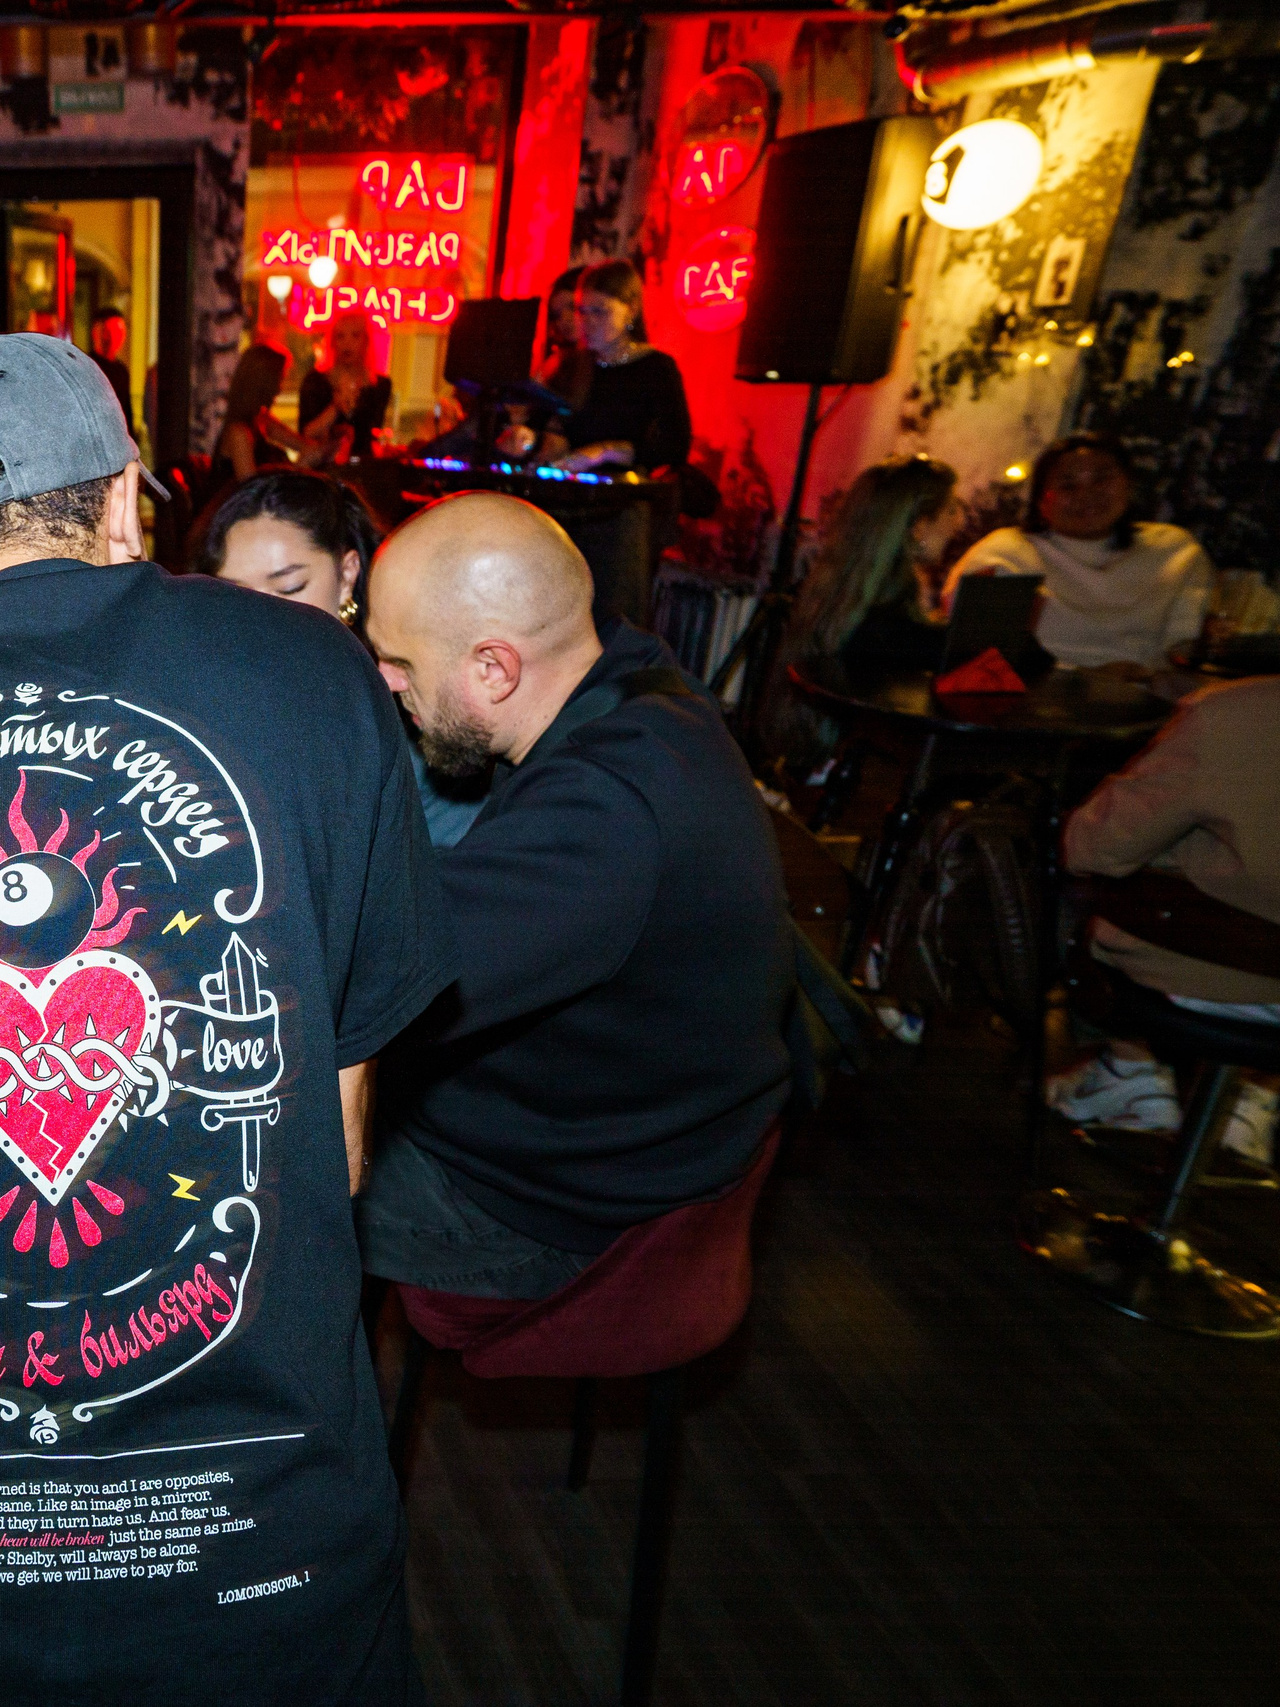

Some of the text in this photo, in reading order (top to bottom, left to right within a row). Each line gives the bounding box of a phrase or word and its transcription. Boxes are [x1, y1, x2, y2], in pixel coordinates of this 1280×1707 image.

[2, 870, 28, 902] 8
[203, 1021, 268, 1073] love
[22, 1330, 65, 1388] &
[80, 1263, 234, 1378] бильярд
[29, 1483, 41, 1495] is
[43, 1481, 71, 1495] that
[74, 1483, 99, 1496] you
[102, 1480, 128, 1495] and
[130, 1479, 137, 1492] I
[140, 1479, 163, 1490] are
[165, 1471, 234, 1489] opposites,
[37, 1499, 68, 1512] Like
[70, 1500, 87, 1511] an
[90, 1498, 131, 1512] image
[134, 1495, 149, 1508] in
[151, 1497, 161, 1506] a
[162, 1490, 212, 1505] mirror.
[0, 1533, 29, 1547] heart
[30, 1533, 51, 1547] will
[51, 1533, 65, 1546] be
[65, 1531, 105, 1546] broken
[107, 1531, 137, 1547] just
[138, 1528, 162, 1541] the
[165, 1526, 201, 1539] same
[204, 1524, 219, 1535] as
[221, 1518, 257, 1533] mine.
[7, 1516, 38, 1532] they
[40, 1517, 55, 1529] in
[57, 1516, 89, 1529] turn
[91, 1514, 123, 1528] hate
[125, 1513, 146, 1525] us.
[148, 1509, 178, 1523] And
[180, 1507, 209, 1521] fear
[211, 1505, 231, 1518] us.
[7, 1552, 57, 1567] Shelby,
[60, 1550, 86, 1564] will
[88, 1549, 137, 1564] always
[140, 1545, 157, 1559] be
[159, 1543, 200, 1556] alone.
[17, 1570, 40, 1586] get
[42, 1571, 63, 1582] we
[65, 1567, 91, 1580] will
[94, 1566, 128, 1579] have
[131, 1566, 145, 1577] to
[147, 1563, 174, 1579] pay
[176, 1559, 199, 1573] for.
[217, 1570, 311, 1604] LOMONOSOVA, 1
